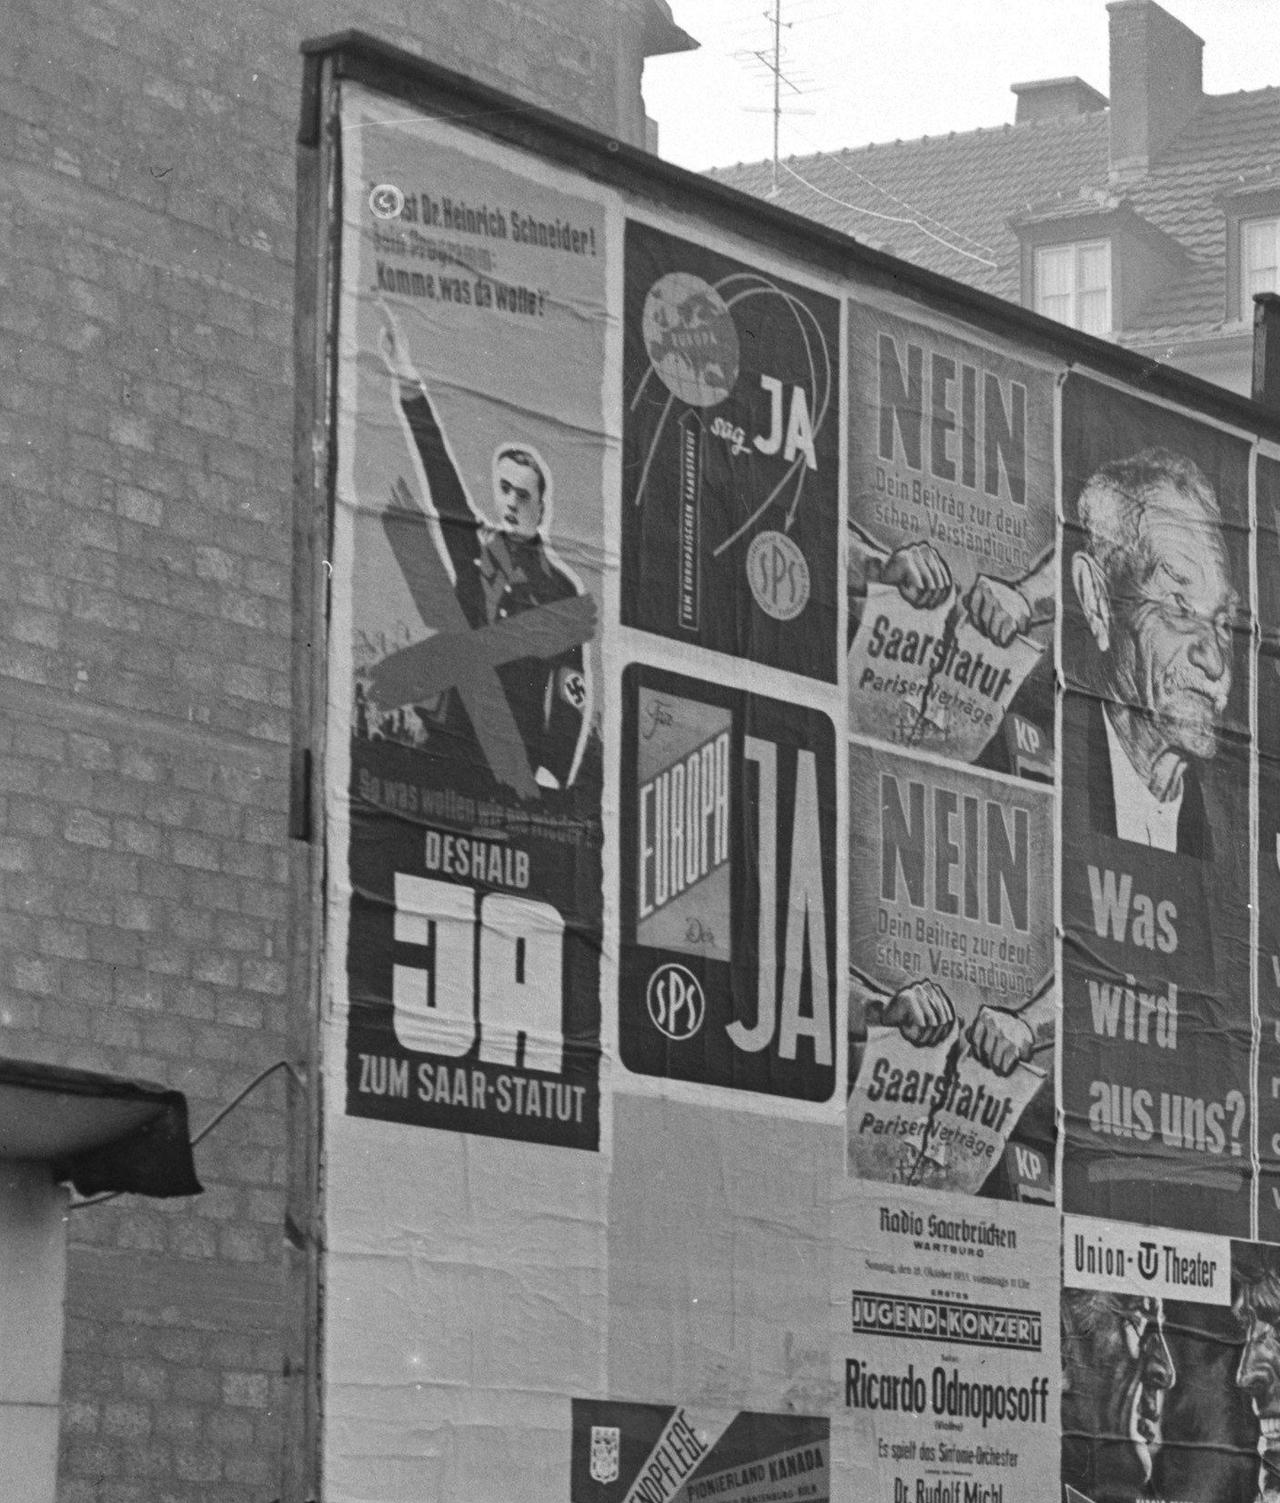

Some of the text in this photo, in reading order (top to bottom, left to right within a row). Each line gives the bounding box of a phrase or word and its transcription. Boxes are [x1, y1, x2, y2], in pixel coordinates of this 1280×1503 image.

[443, 198, 597, 256] Heinrich Schneider!
[438, 276, 471, 305] was
[710, 373, 819, 472] sag JA
[876, 331, 1028, 510] NEIN
[867, 614, 1012, 702] Saarstatut
[859, 667, 995, 728] Pariser Verträge
[639, 731, 730, 922] EUROPA
[879, 773, 1030, 934] NEIN
[425, 830, 530, 889] DESHALB
[725, 735, 832, 1067] JA
[1087, 864, 1178, 954] Was
[876, 907, 912, 959] Dein
[915, 916, 967, 966] Beitrag
[393, 871, 566, 1076] JA
[656, 970, 696, 1035] SPS
[1089, 972, 1178, 1050] wird
[359, 1053, 410, 1100] ZUM
[867, 1057, 1013, 1133] Saarstatut
[859, 1112, 996, 1159] Pariser Verträge
[1089, 1080, 1247, 1157] aus uns?
[880, 1206, 1018, 1250] Radio Saarbrücken
[913, 1241, 985, 1259] WARTBURG
[1162, 1244, 1217, 1289] Theater
[853, 1299, 1042, 1346] JUGEND-KONZERT
[845, 1357, 1049, 1429] Ricardo Odnoposoff
[768, 1448, 824, 1484] KANADA
[878, 1437, 889, 1459] Es
